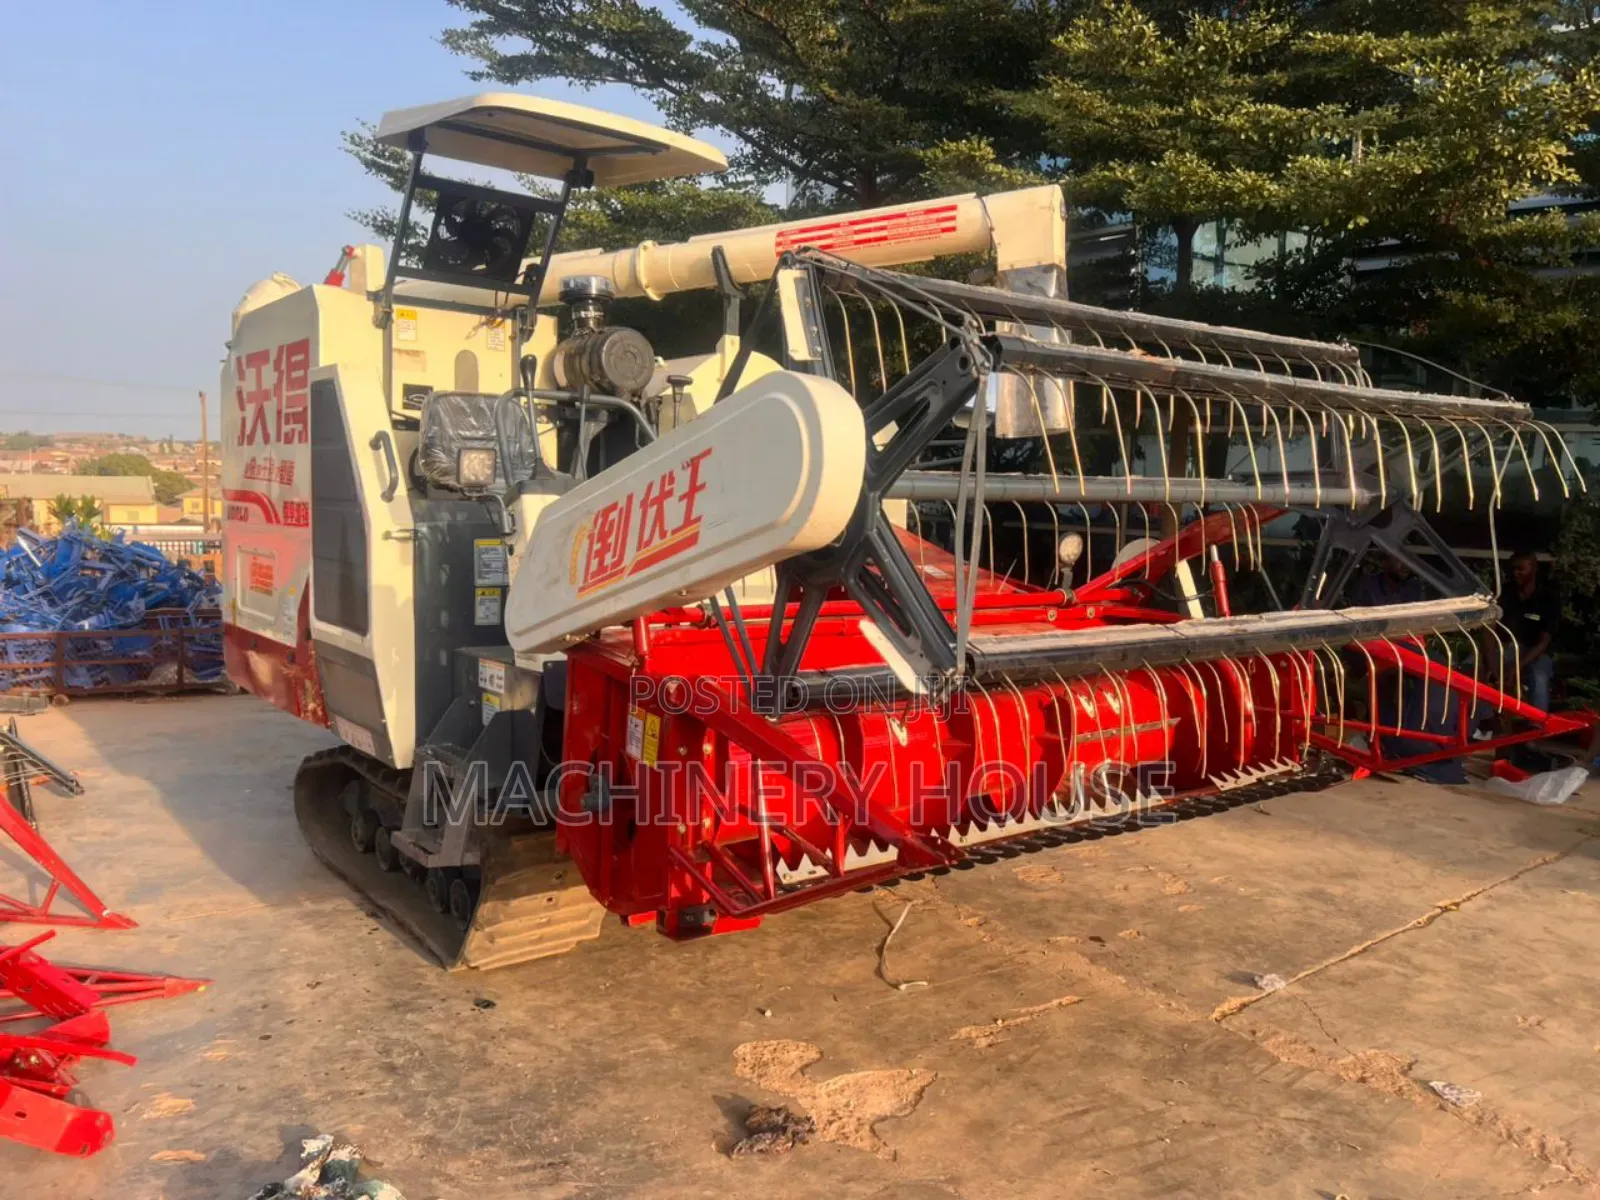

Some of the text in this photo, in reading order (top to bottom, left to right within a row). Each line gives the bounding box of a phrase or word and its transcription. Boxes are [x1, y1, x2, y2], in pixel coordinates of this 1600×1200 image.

[236, 338, 310, 446] 沃得
[583, 447, 713, 585] 倒伏王
